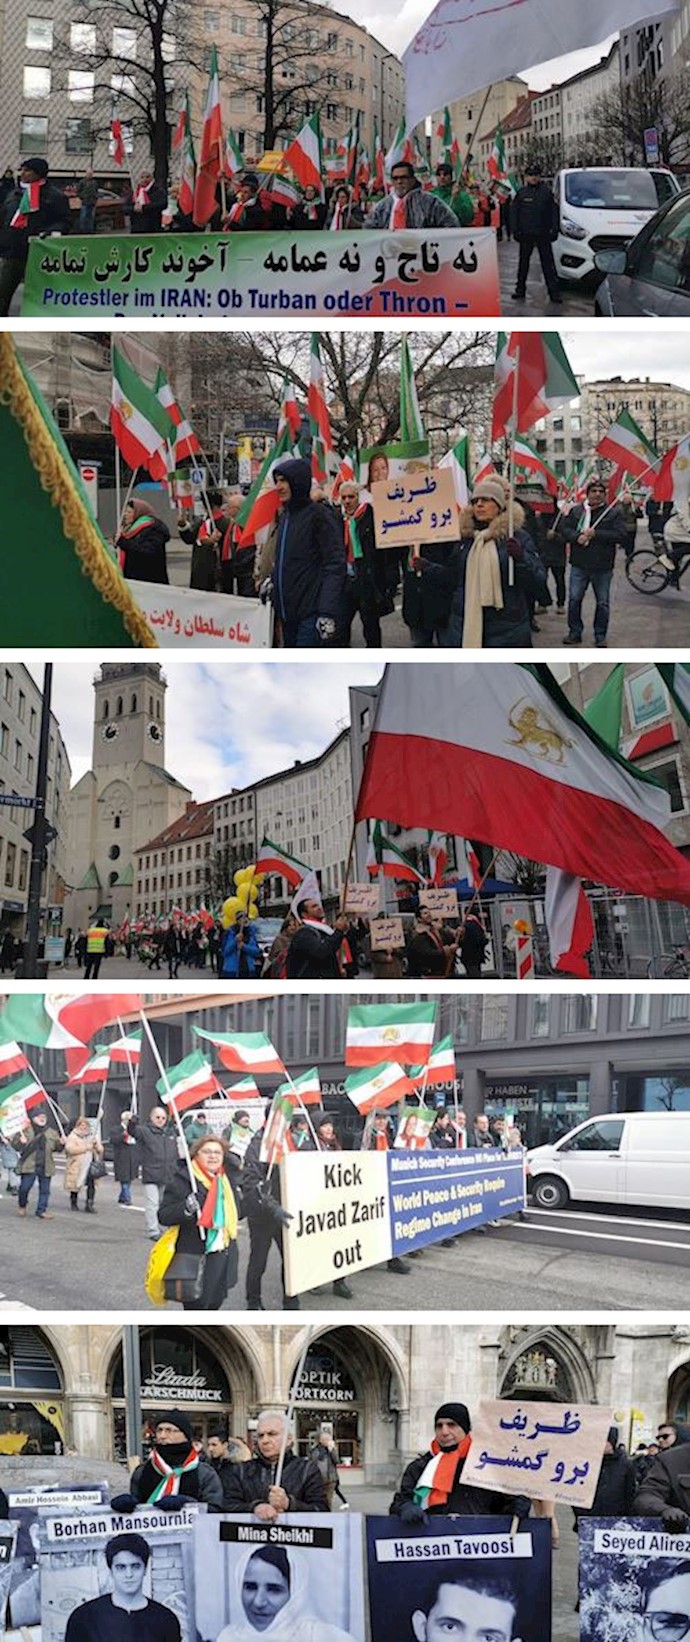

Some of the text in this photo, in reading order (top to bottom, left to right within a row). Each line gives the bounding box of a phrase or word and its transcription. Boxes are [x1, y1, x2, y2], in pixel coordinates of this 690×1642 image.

[41, 247, 88, 274] تمامه
[94, 247, 154, 283] کارش
[162, 241, 231, 283] آخوند
[263, 243, 328, 273] عمامه
[339, 242, 361, 273] نه
[372, 254, 386, 283] و
[397, 241, 440, 283] تاج
[453, 241, 478, 273] نه
[43, 288, 129, 307] Protestler
[135, 288, 155, 307] im
[161, 289, 212, 308] IRAN:
[218, 289, 243, 308] Ob
[249, 289, 316, 310] Turban
[324, 291, 373, 311] oder
[380, 292, 446, 313] Thron
[387, 476, 437, 503] ظریف
[430, 508, 452, 528] برو
[184, 614, 225, 638] سلطان
[229, 621, 251, 643] شاه
[52, 910, 60, 920] P
[322, 1083, 346, 1096] BAC
[324, 1163, 362, 1188] Kick
[392, 1190, 422, 1213] World
[423, 1189, 450, 1206] Peace
[450, 1184, 457, 1200] &
[457, 1181, 483, 1198] Security
[296, 1196, 385, 1237] Javad Zarif
[395, 1216, 431, 1240] Regime
[432, 1207, 461, 1228] Change
[333, 1239, 362, 1269] out
[145, 1363, 207, 1387] Linda
[298, 1370, 342, 1385] OPTIK
[139, 1385, 223, 1400] ARSCHMUCK
[500, 1408, 582, 1440] ظریف
[550, 1460, 590, 1485] برو
[54, 1511, 194, 1537] Borhan Mansournia
[237, 1526, 314, 1543] Mina Sheikhi
[395, 1537, 515, 1558] Hassan Tavoosi
[601, 1533, 645, 1553] Seyed
